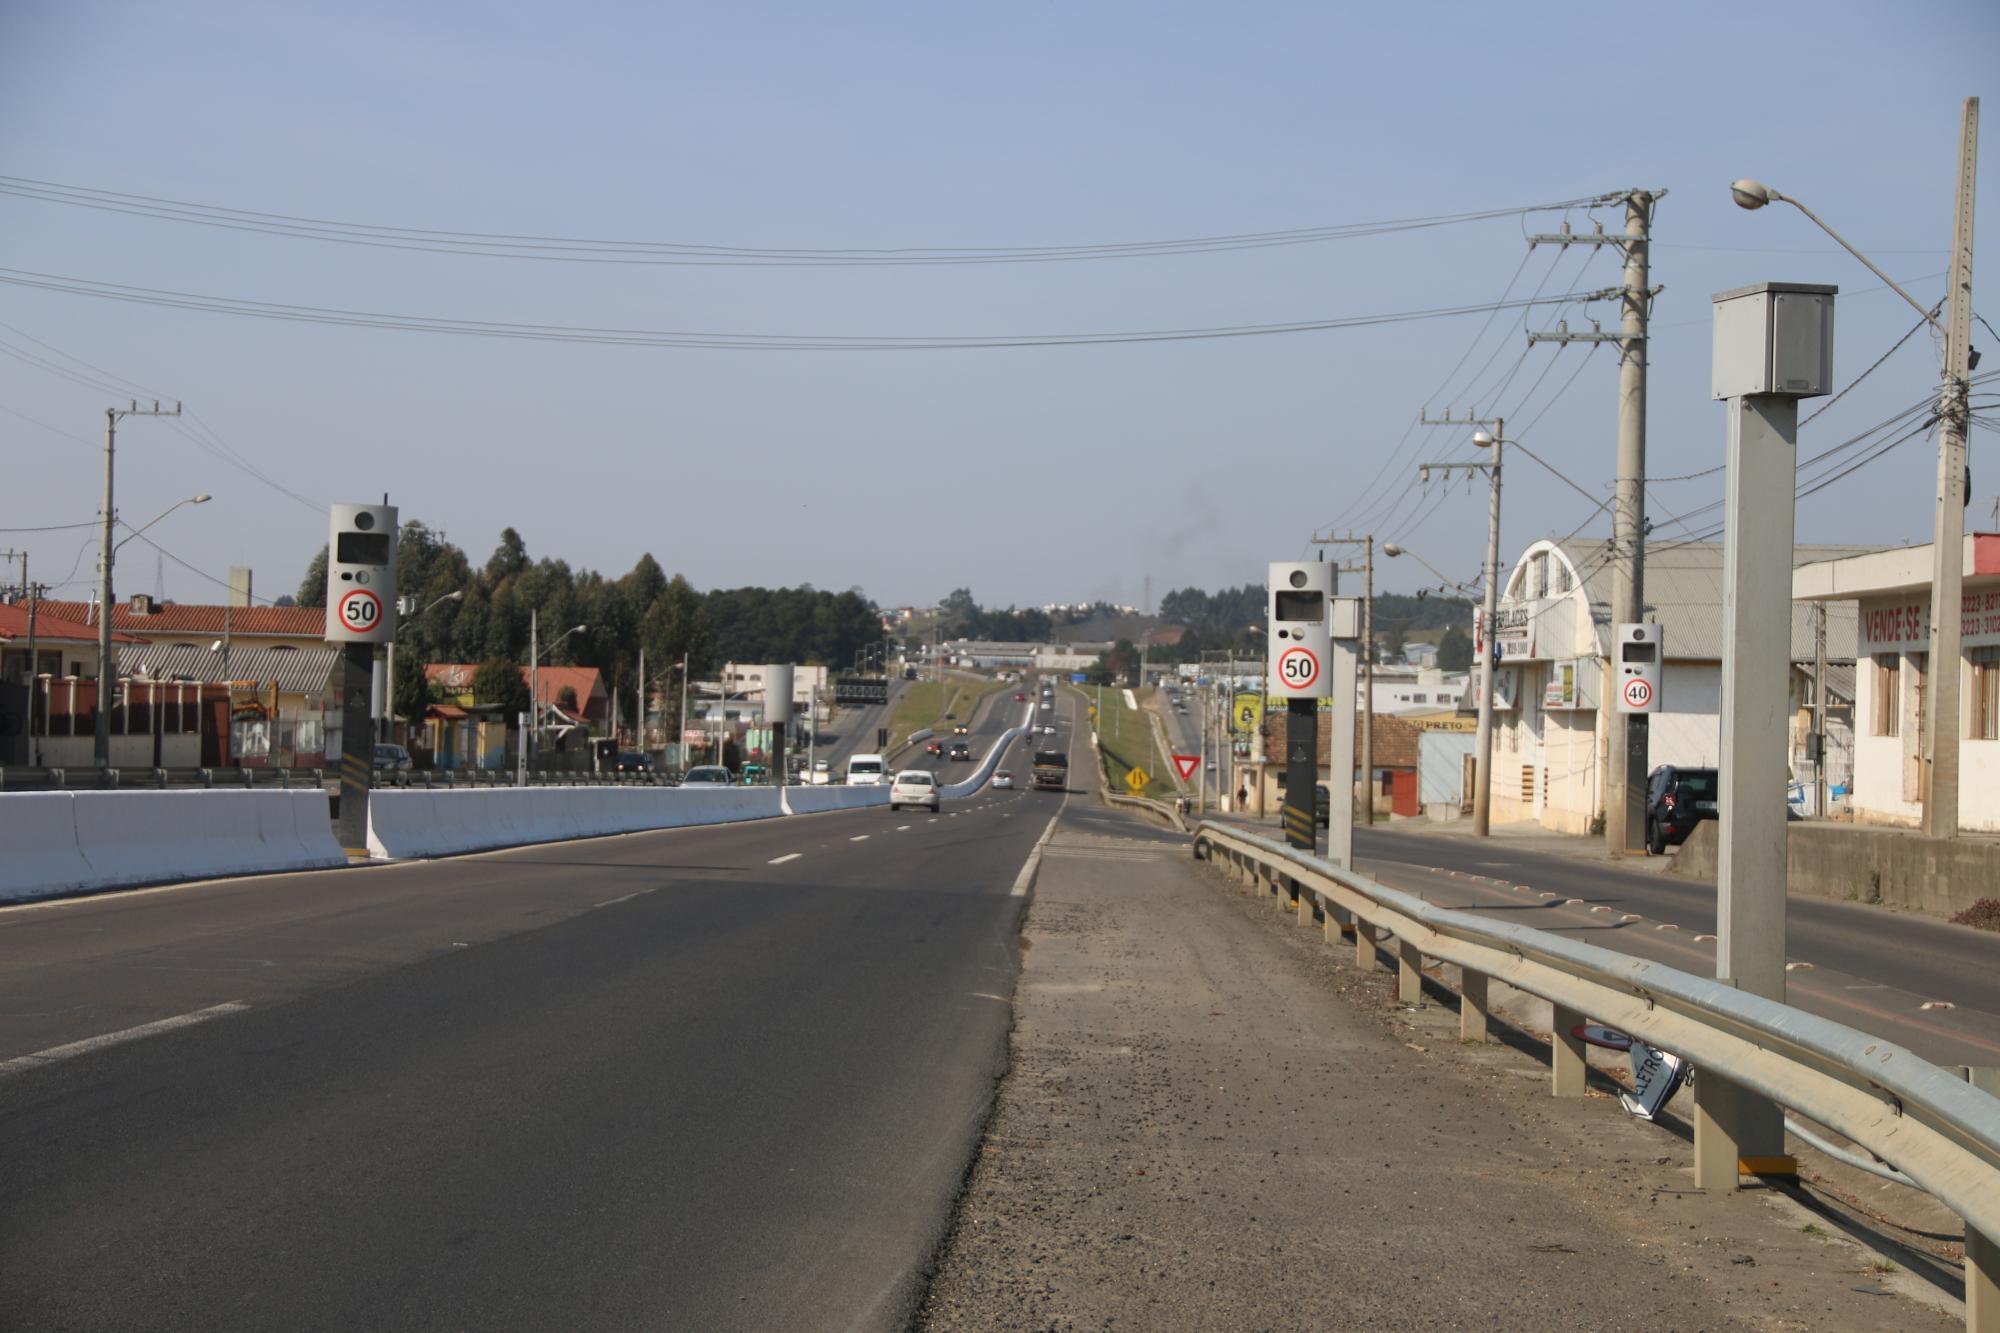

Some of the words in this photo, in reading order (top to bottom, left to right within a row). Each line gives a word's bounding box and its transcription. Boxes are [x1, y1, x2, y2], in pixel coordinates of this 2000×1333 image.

[347, 601, 375, 621] 50
[1865, 605, 1920, 643] VENDE-SE
[1285, 658, 1312, 678] 50
[1629, 686, 1647, 699] 40
[1426, 721, 1463, 730] PRETO
